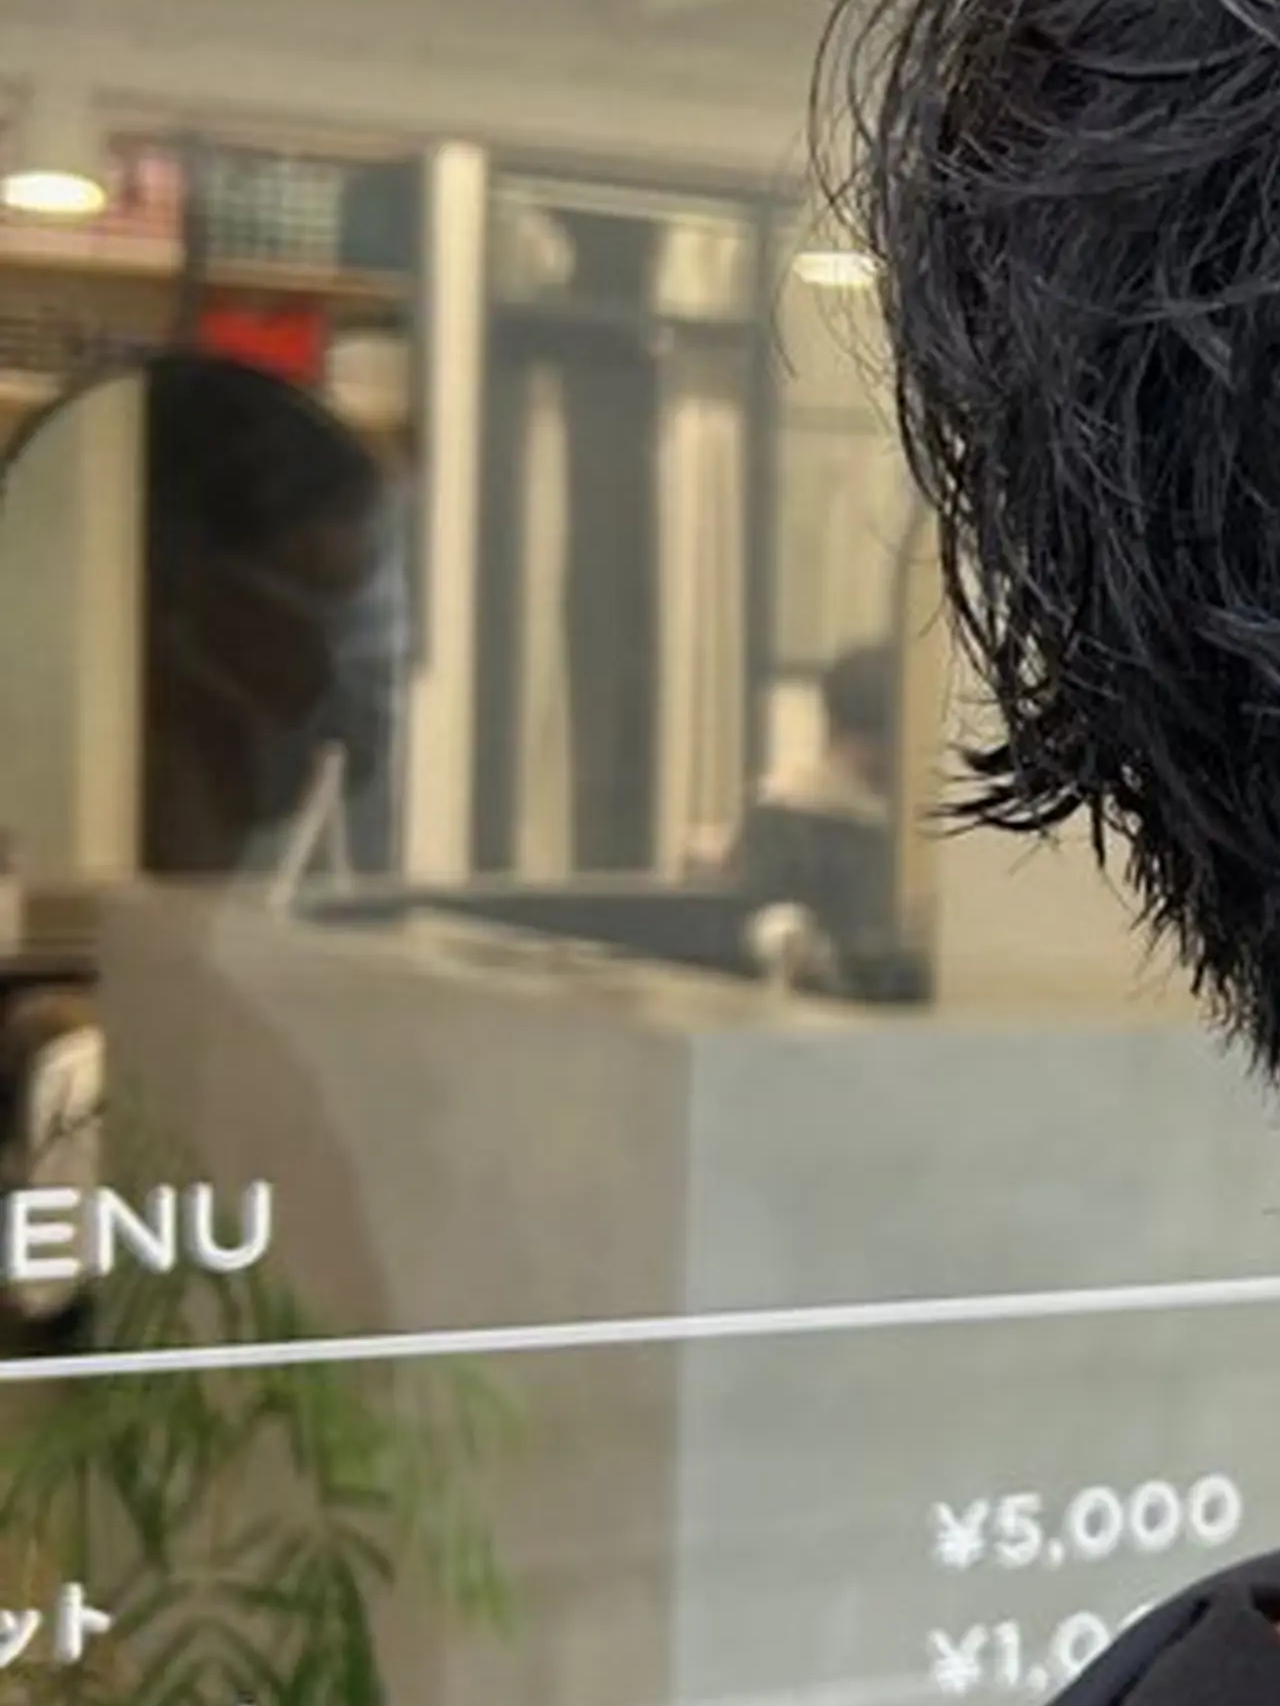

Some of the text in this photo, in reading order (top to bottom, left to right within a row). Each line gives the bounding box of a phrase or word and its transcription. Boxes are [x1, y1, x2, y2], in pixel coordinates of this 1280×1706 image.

[10, 1179, 273, 1279] ENU
[931, 1474, 1242, 1569] ¥5,000
[927, 1605, 1153, 1695] ¥1,0
